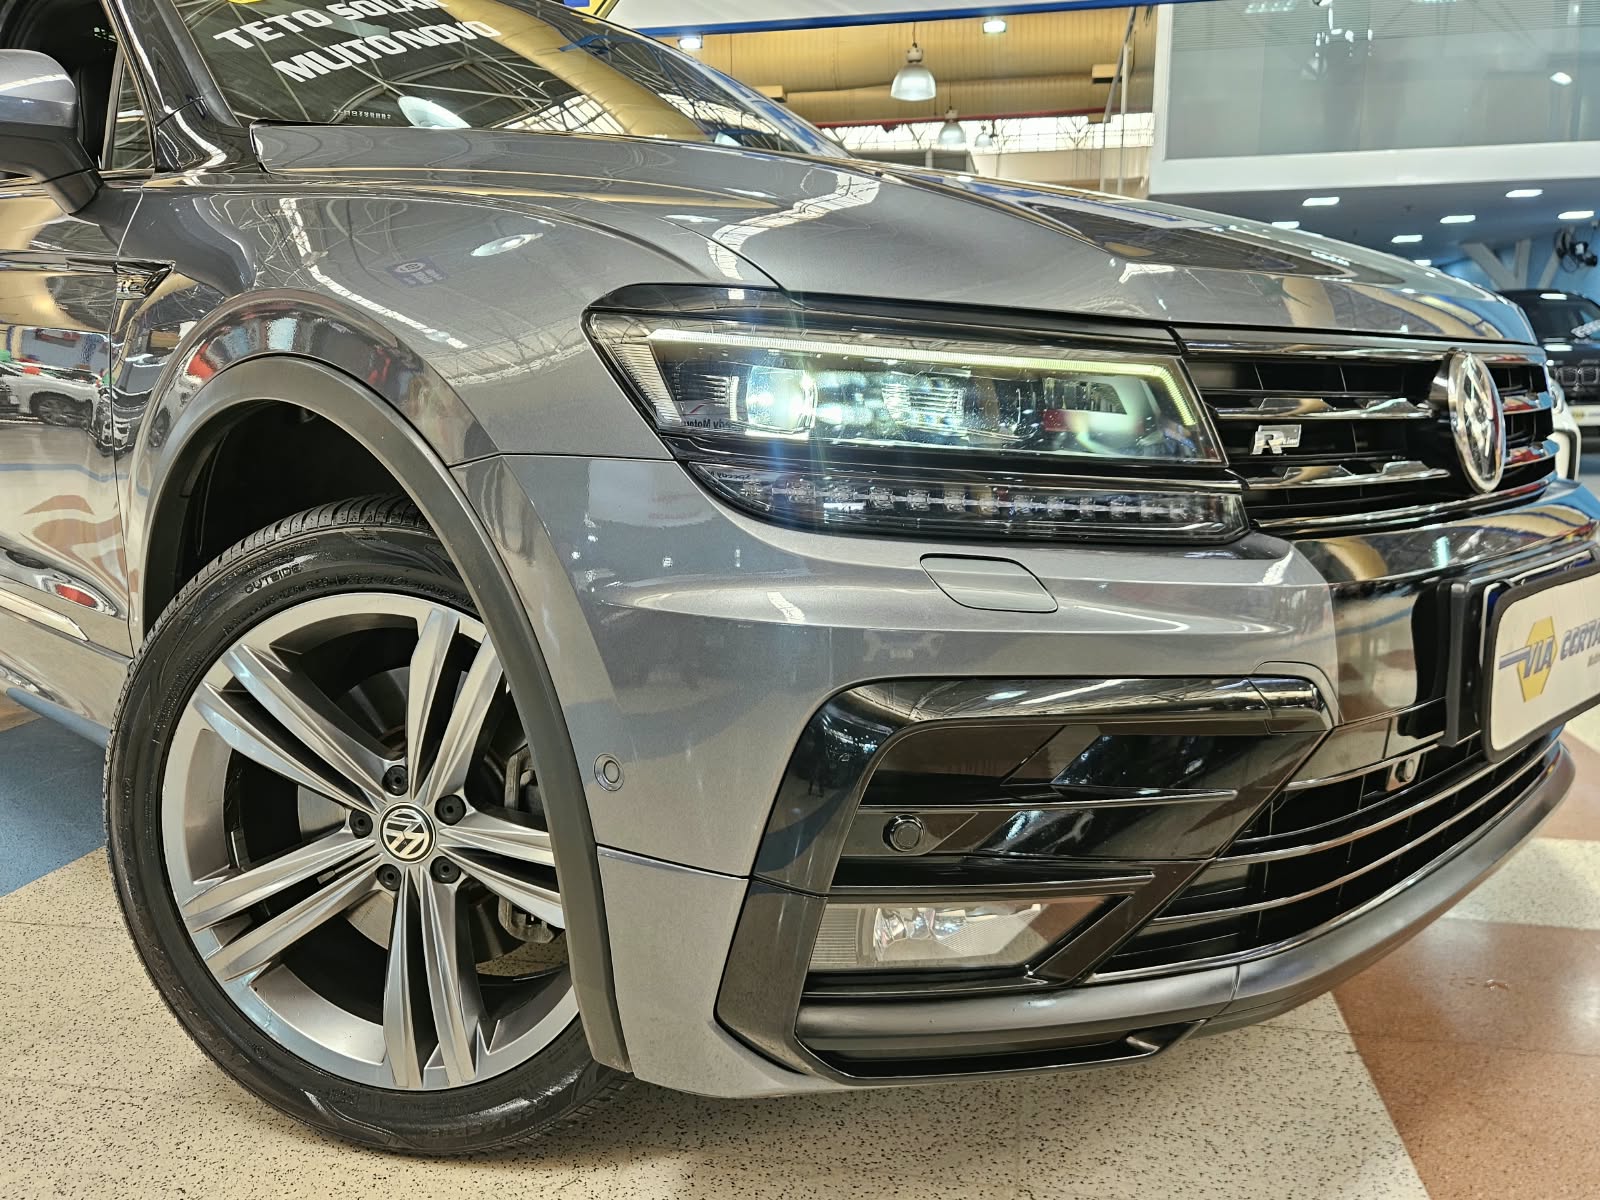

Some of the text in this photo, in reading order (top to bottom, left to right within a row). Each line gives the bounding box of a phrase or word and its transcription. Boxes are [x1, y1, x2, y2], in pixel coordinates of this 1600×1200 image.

[213, 9, 333, 49] TETO
[271, 21, 501, 82] MUITO NOVO
[1251, 431, 1283, 454] R
[244, 562, 302, 594] OUTSIDE
[1523, 635, 1556, 679] VIA
